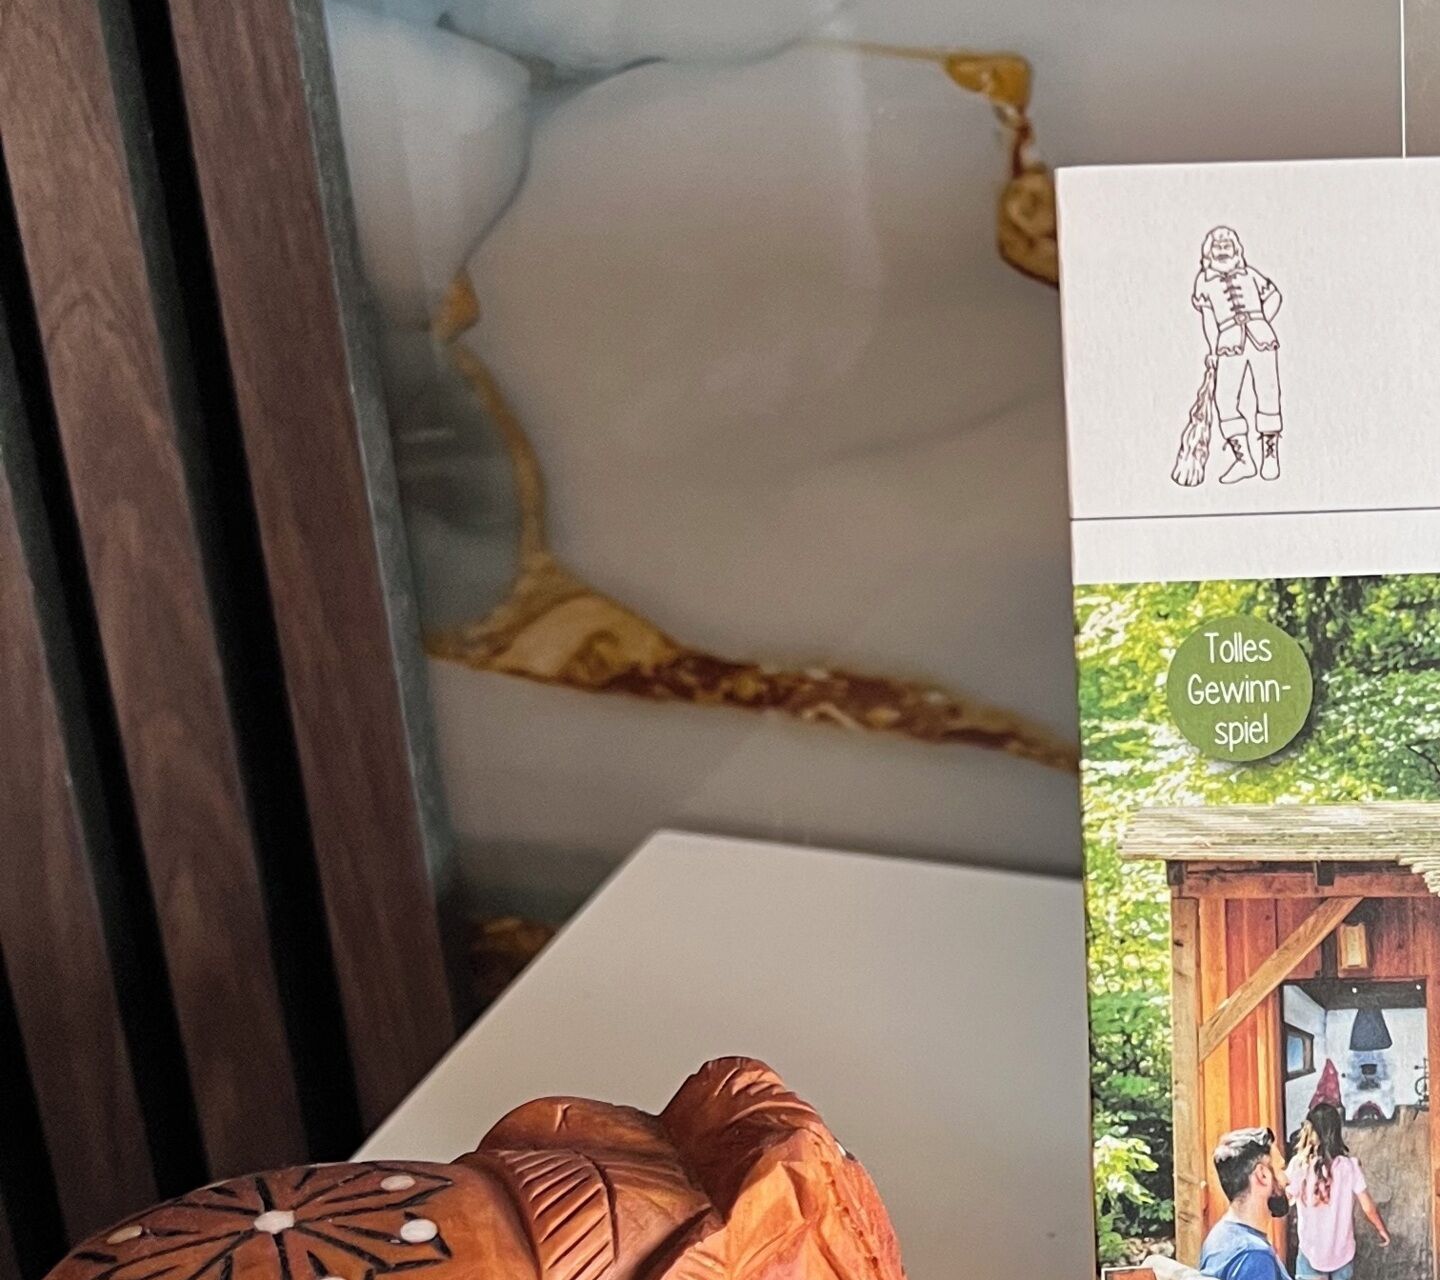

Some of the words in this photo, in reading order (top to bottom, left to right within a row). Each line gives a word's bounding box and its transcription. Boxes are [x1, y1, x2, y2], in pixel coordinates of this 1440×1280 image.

[1203, 631, 1273, 664] Tolles
[1187, 673, 1291, 705] Gewinn-
[1214, 712, 1269, 753] spiel
